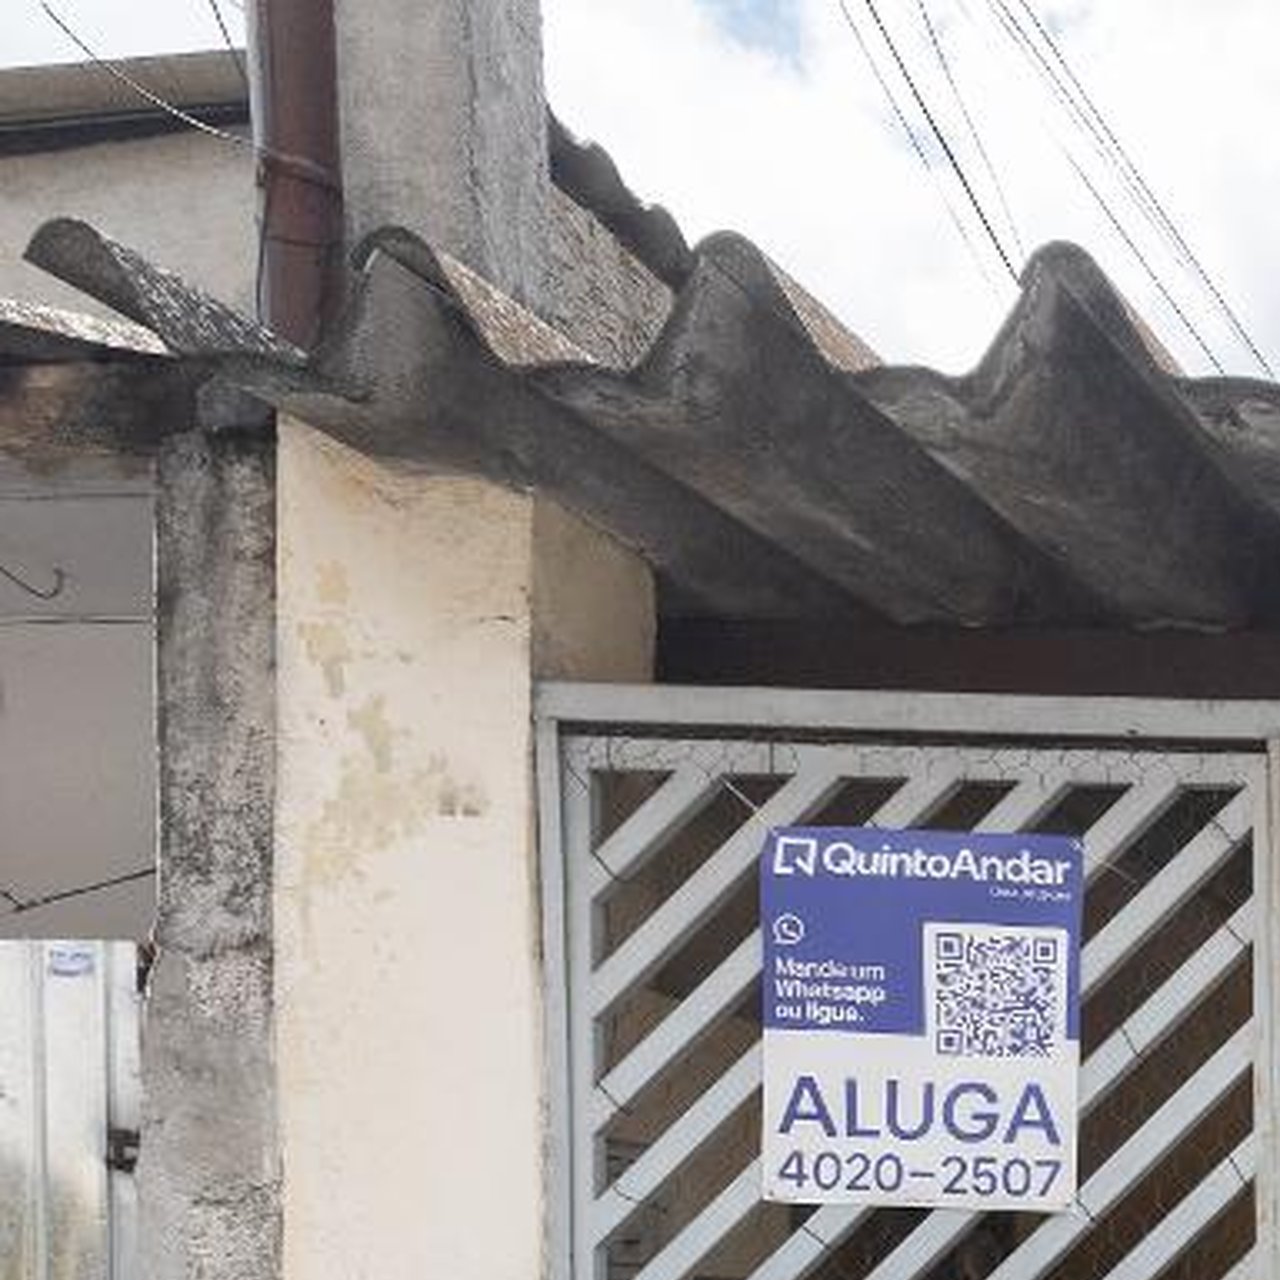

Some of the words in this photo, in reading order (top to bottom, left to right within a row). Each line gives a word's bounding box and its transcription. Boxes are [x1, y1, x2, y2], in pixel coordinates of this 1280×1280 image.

[823, 842, 1071, 884] QuintoAndar
[776, 957, 848, 978] Mande
[850, 966, 885, 981] um
[776, 980, 886, 1006] Whatsapp
[776, 1006, 801, 1018] ou
[806, 1001, 864, 1024] ligue.
[779, 1076, 1061, 1145] ALUGA
[779, 1151, 1062, 1196] 4020-2507
